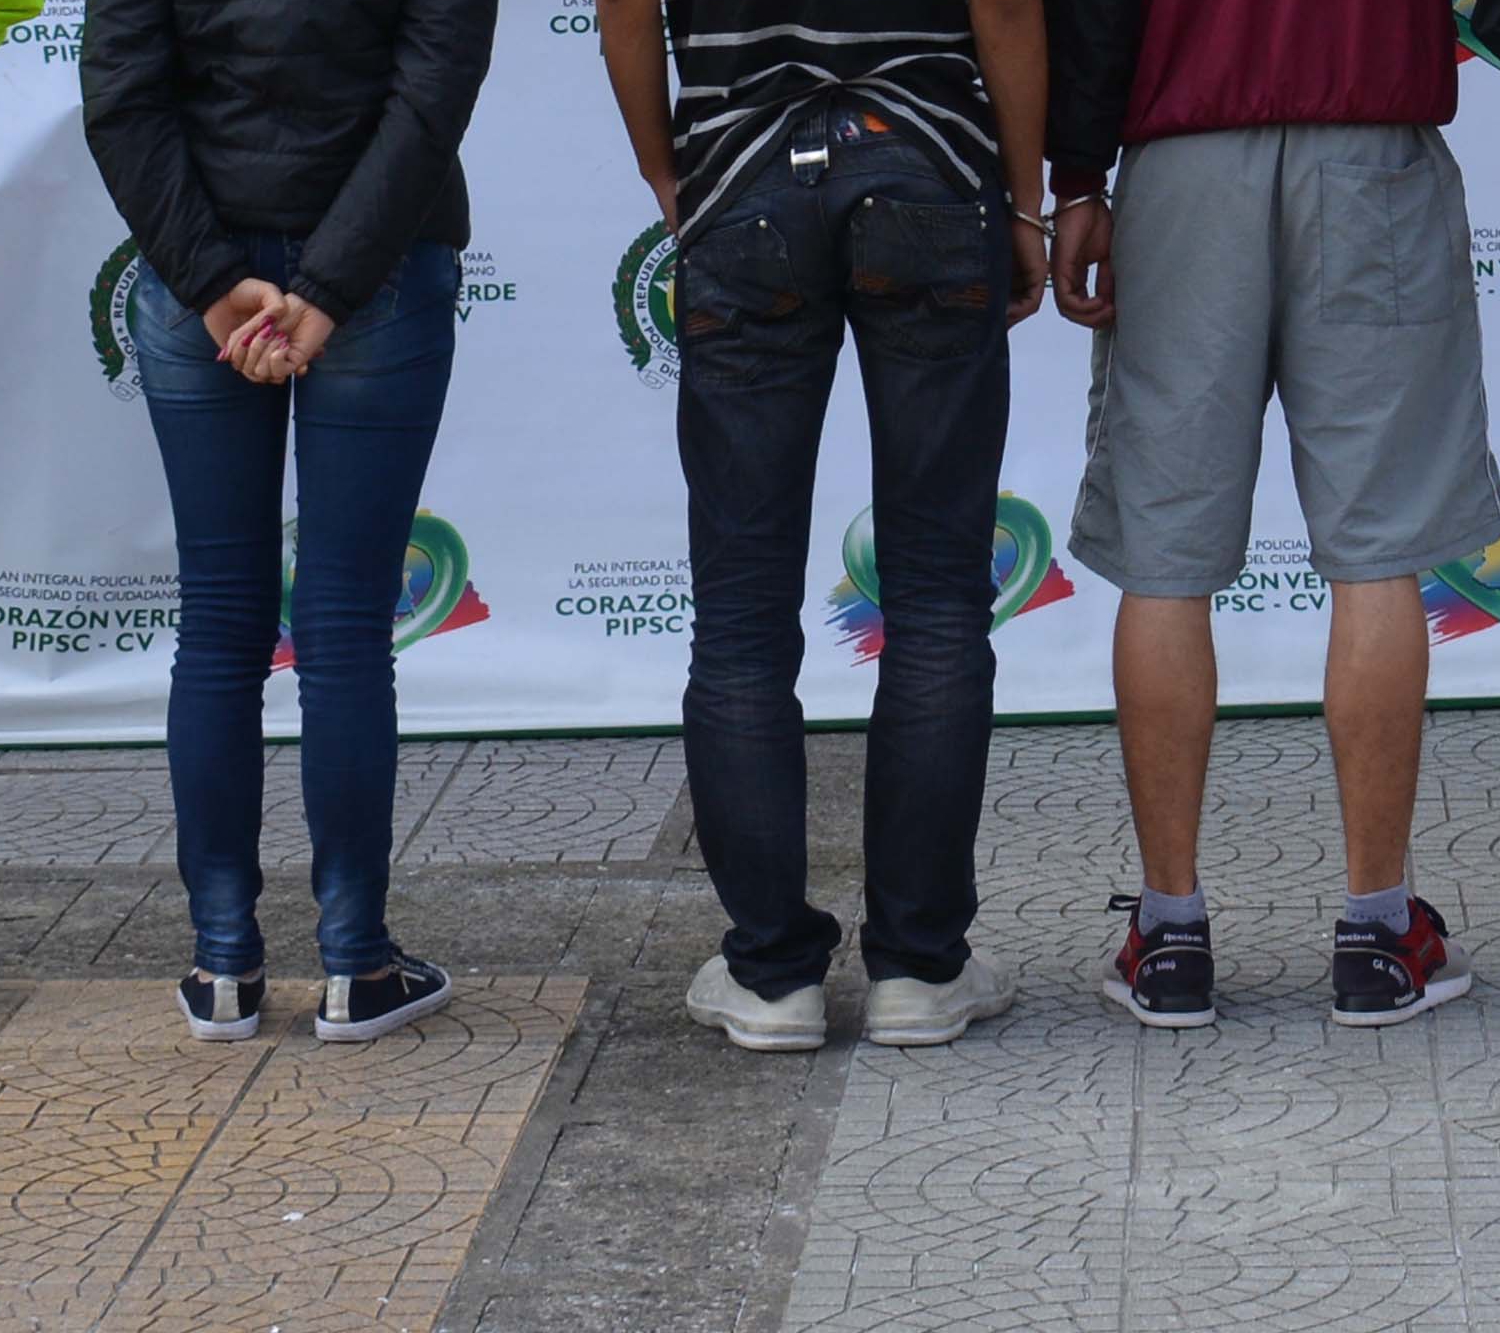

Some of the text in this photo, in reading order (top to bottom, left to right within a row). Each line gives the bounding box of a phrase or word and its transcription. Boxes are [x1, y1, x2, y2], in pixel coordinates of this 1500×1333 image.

[115, 608, 182, 629] VERD
[606, 615, 684, 637] PIPSC
[12, 631, 91, 653] PIPSC
[115, 632, 155, 653] CV
